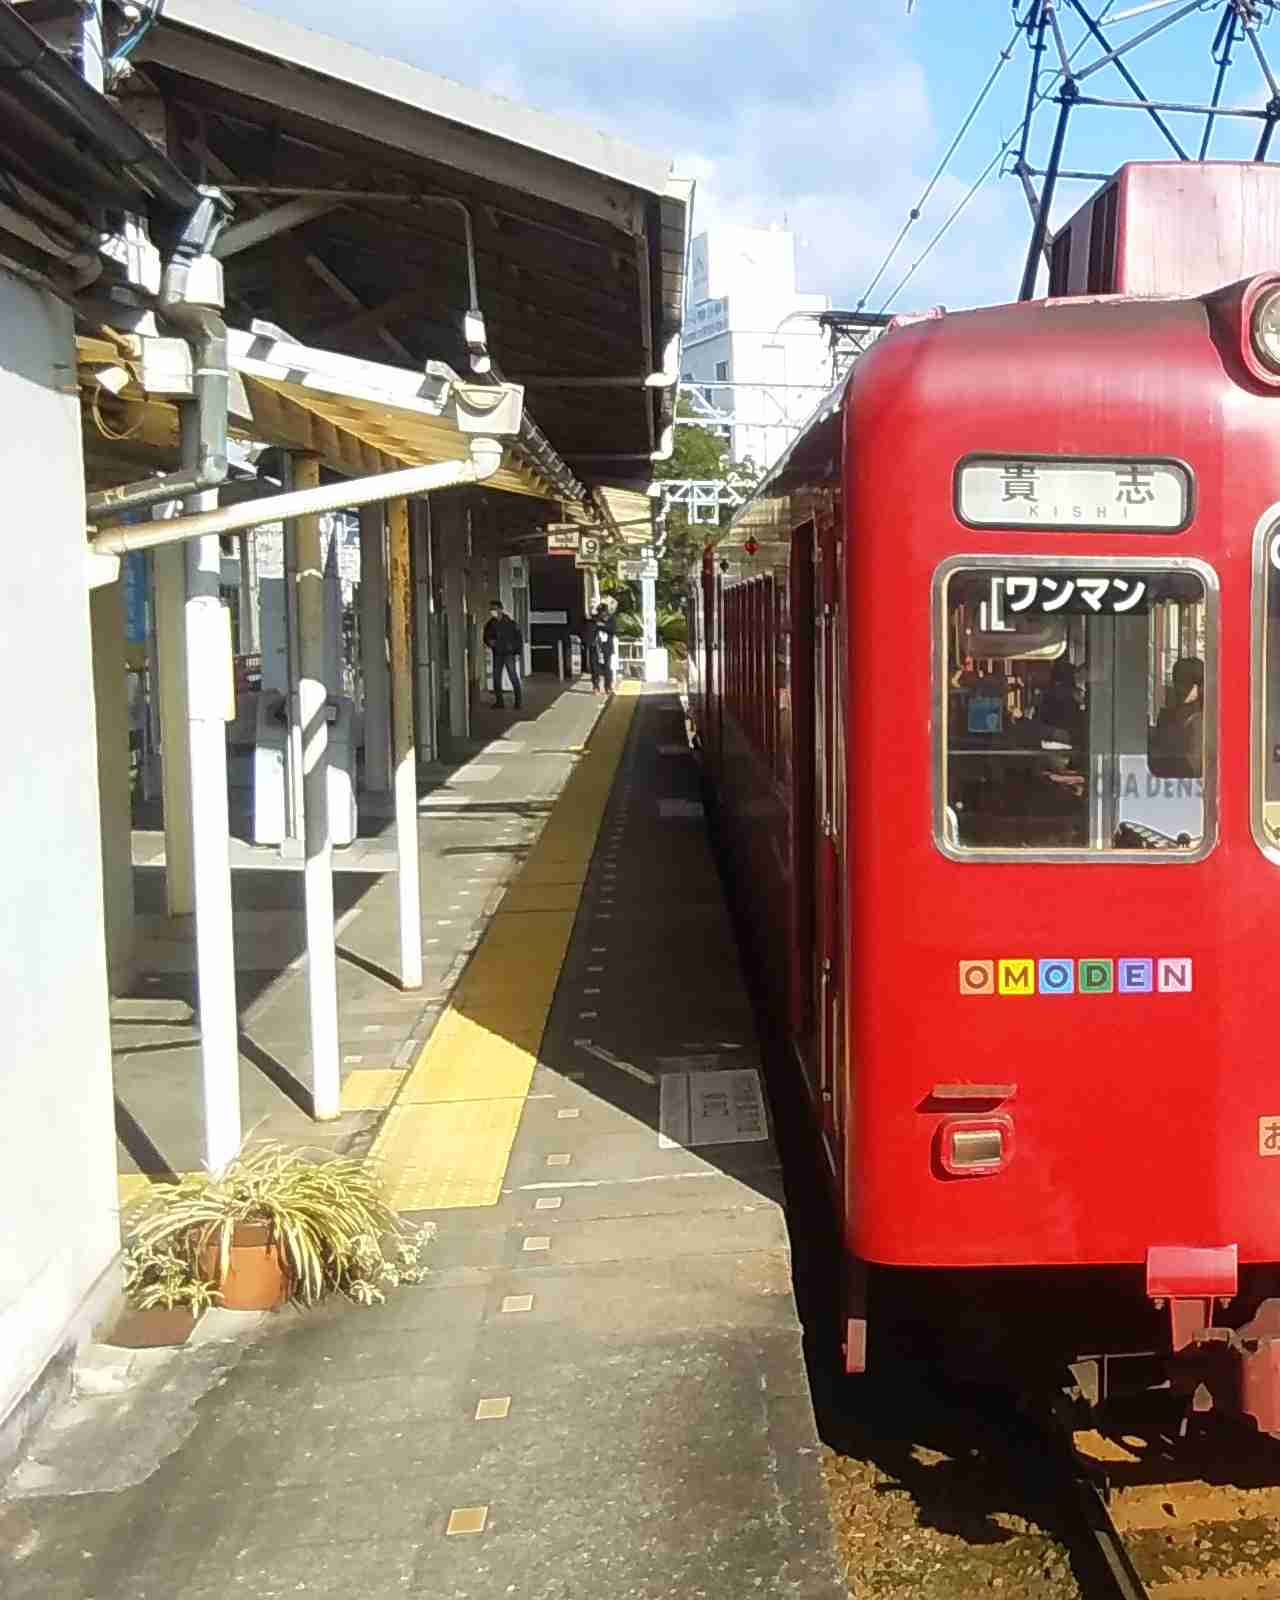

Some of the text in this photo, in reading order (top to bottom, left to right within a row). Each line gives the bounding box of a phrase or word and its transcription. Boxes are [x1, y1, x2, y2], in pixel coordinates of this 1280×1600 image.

[999, 463, 1155, 505] 貴志
[1028, 505, 1129, 519] KISHI
[585, 539, 598, 554] 9
[1005, 576, 1146, 612] ワンマン
[963, 963, 1188, 990] OMODEN
